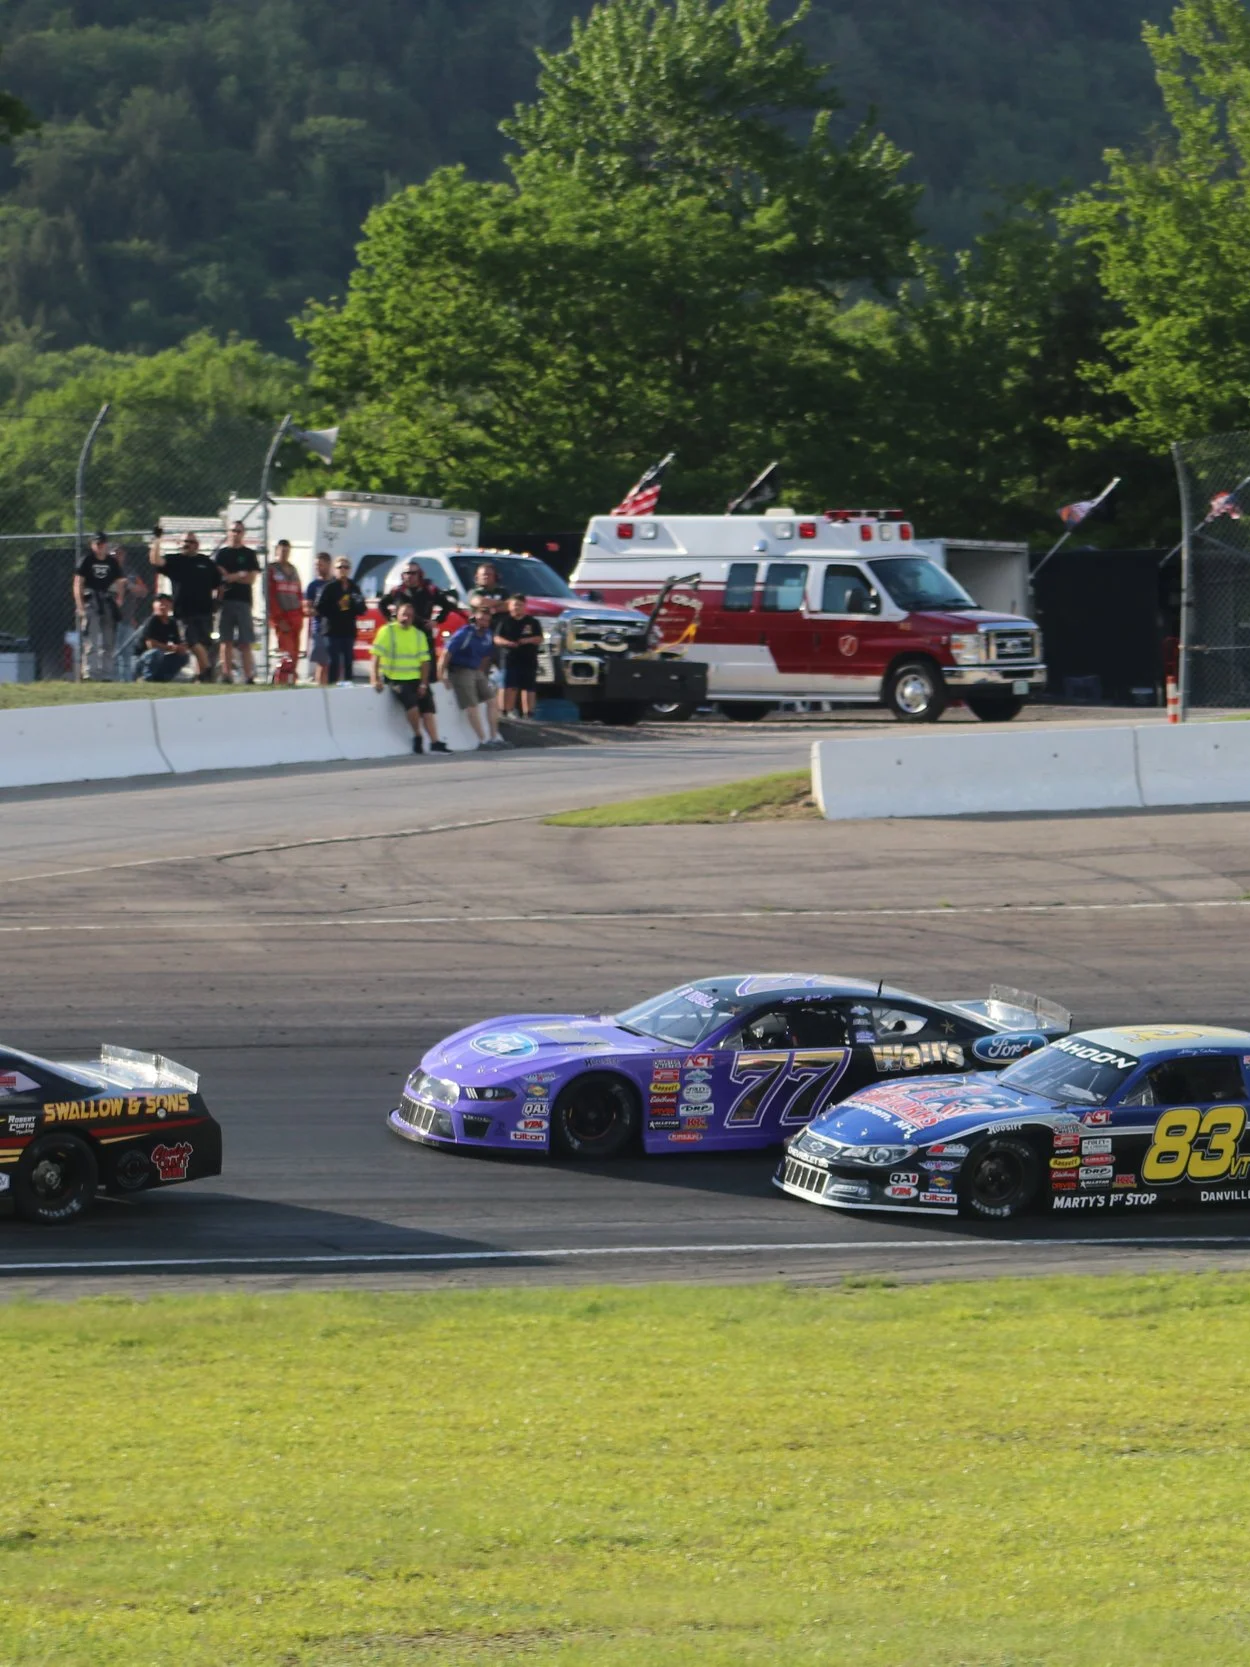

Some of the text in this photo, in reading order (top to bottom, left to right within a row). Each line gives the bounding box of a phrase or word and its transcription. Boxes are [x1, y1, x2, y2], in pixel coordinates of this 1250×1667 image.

[987, 1033, 1033, 1058] Ford
[684, 1054, 714, 1068] ACT
[869, 1041, 965, 1072] Wall's
[1050, 1038, 1138, 1070] CAHOON
[724, 1047, 853, 1129] 77
[43, 1092, 191, 1122] SWALLOW & SONS
[523, 1102, 549, 1116] QA1
[8, 1114, 37, 1124] ROBERT
[1082, 1110, 1113, 1124] ACT
[8, 1122, 36, 1132] CURTIS
[1141, 1104, 1247, 1186] 83
[891, 1174, 917, 1185] QA1
[922, 1194, 955, 1203] tilton
[1053, 1195, 1106, 1209] MARTY'S
[1125, 1192, 1157, 1205] STOP
